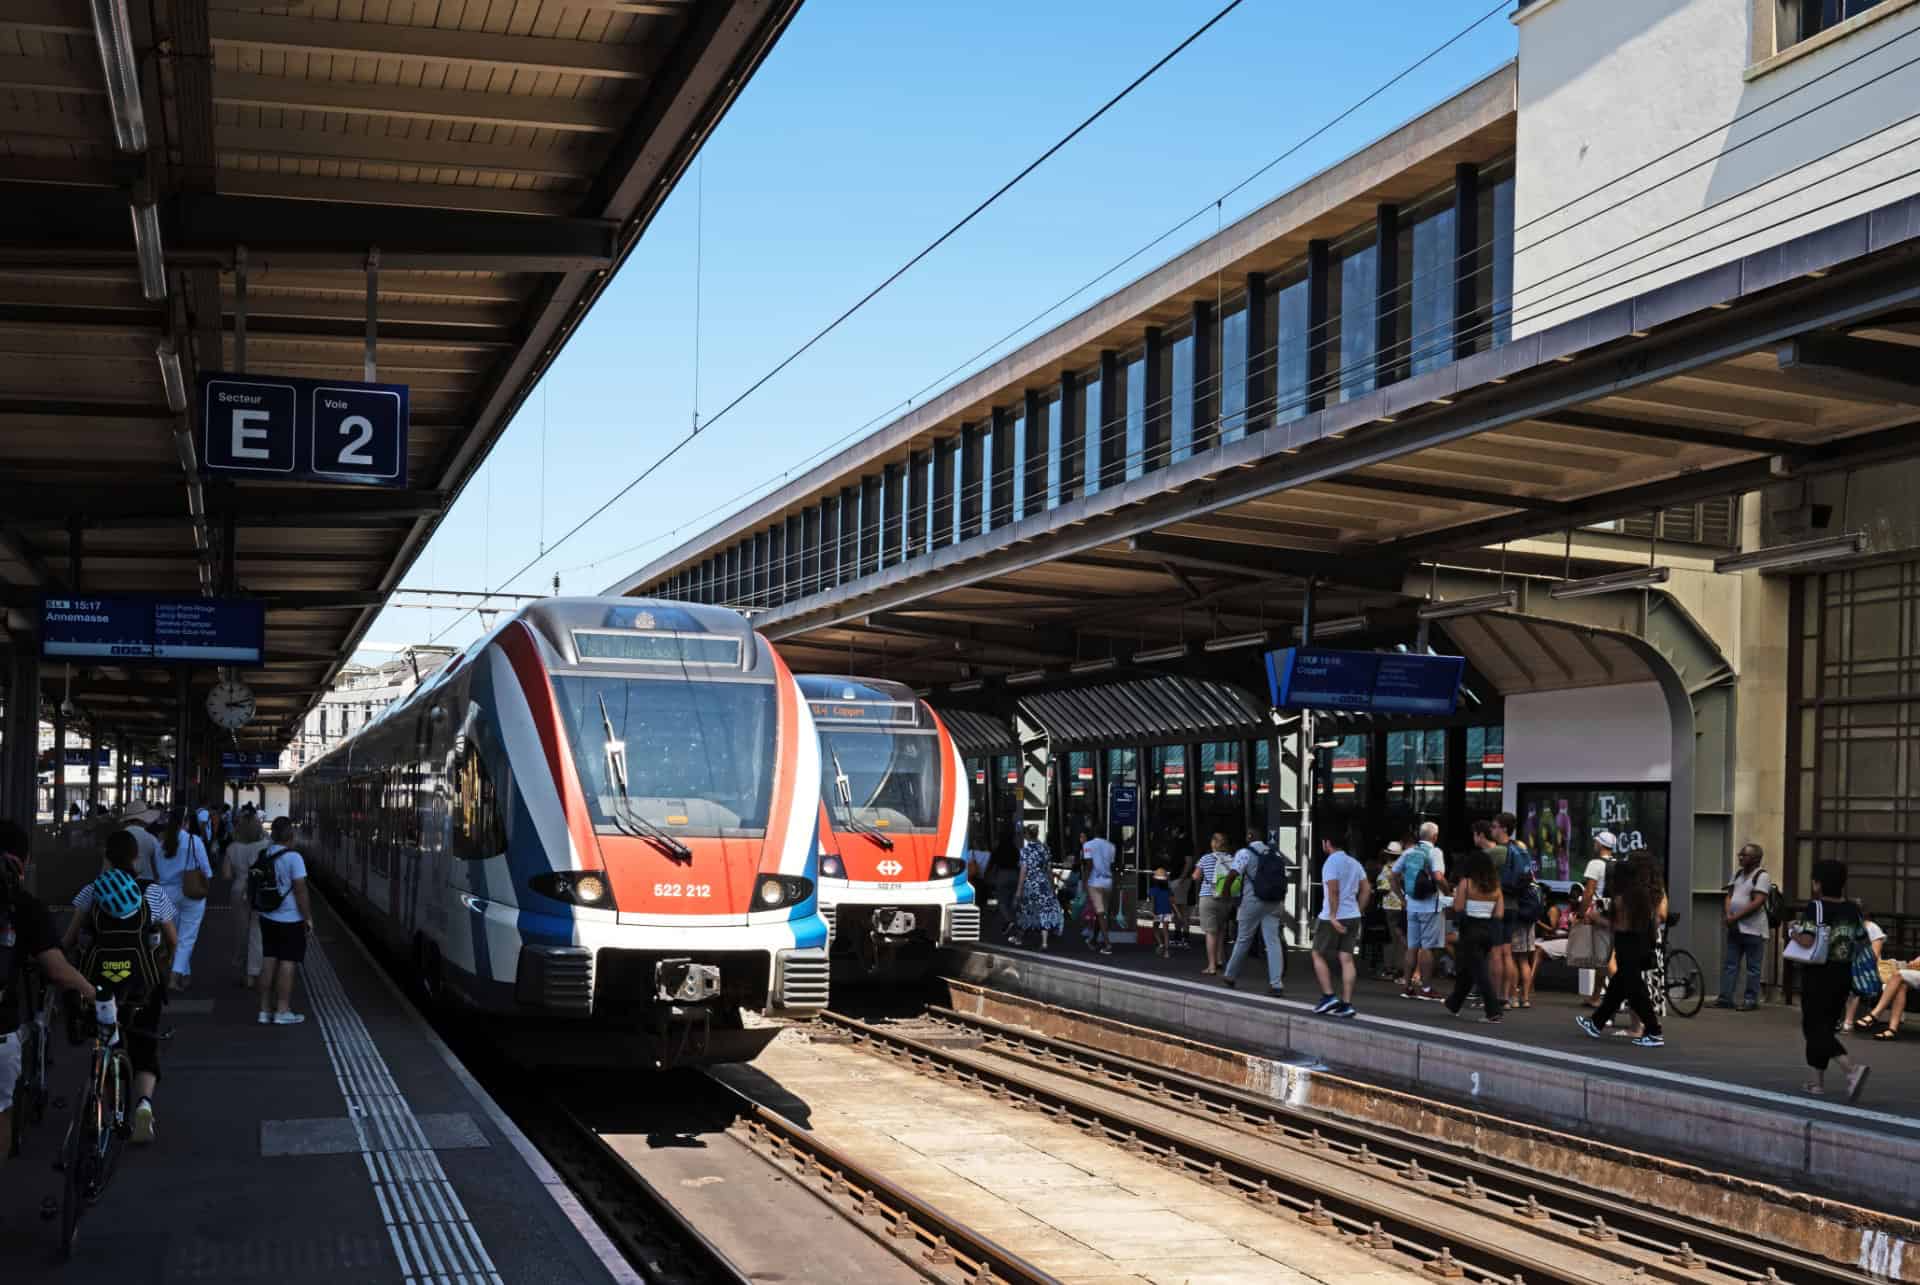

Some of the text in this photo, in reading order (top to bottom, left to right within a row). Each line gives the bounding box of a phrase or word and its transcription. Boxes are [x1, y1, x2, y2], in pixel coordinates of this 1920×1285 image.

[218, 392, 262, 404] Secteur
[324, 400, 348, 409] Voie
[231, 408, 270, 459] E
[337, 415, 374, 465] 2
[46, 612, 109, 623] Annemasse
[654, 883, 711, 897] 522 212
[102, 960, 131, 970] arena
